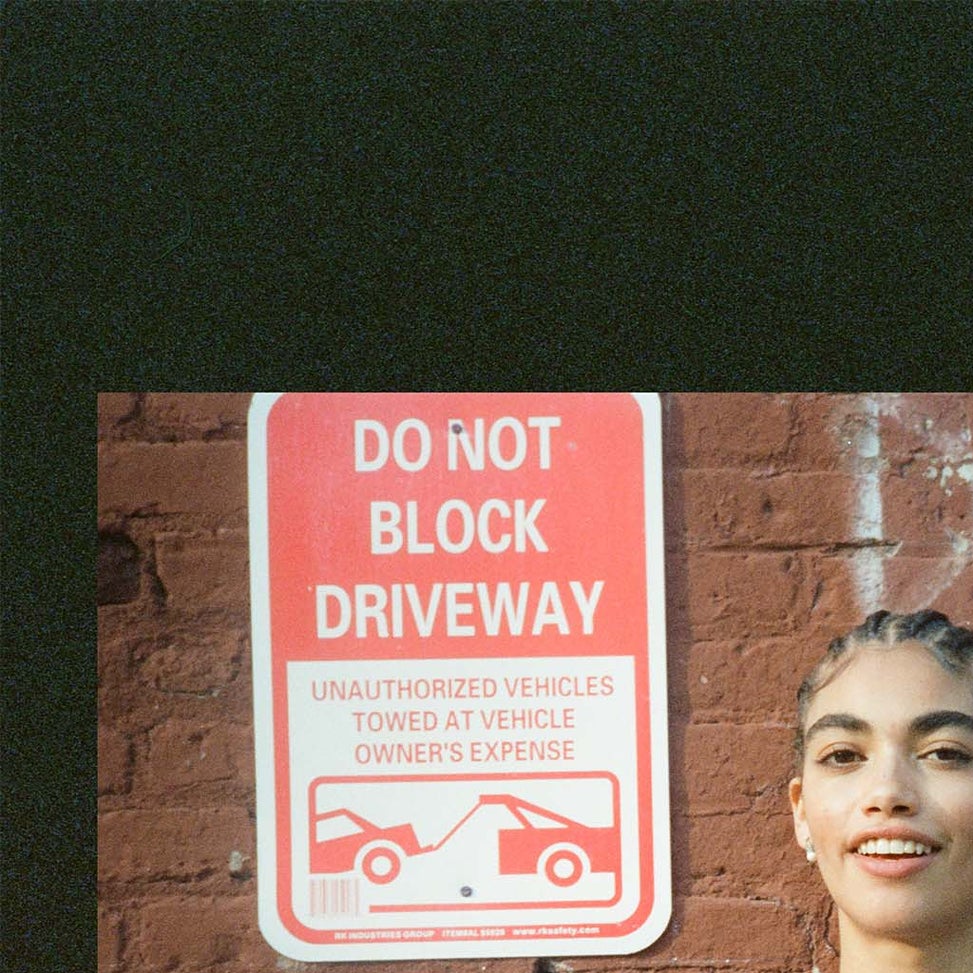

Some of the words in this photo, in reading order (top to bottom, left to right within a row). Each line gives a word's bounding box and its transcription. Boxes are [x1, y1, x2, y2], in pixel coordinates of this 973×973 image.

[354, 418, 432, 473] DO
[447, 416, 561, 471] NOT
[370, 498, 549, 555] BLOCK
[315, 580, 606, 640] DRIVEWAY
[311, 678, 497, 701] UNAUTHORIZED
[504, 675, 615, 697] VEHICLES
[352, 710, 438, 732] TOWED
[444, 710, 475, 730] AT
[478, 708, 576, 730] VEHICLE
[354, 743, 464, 765] OWNER'S
[470, 740, 575, 762] EXPENSE
[334, 932, 348, 940] RK
[349, 930, 401, 940] INDUSTRIES
[403, 929, 435, 939] GROUP
